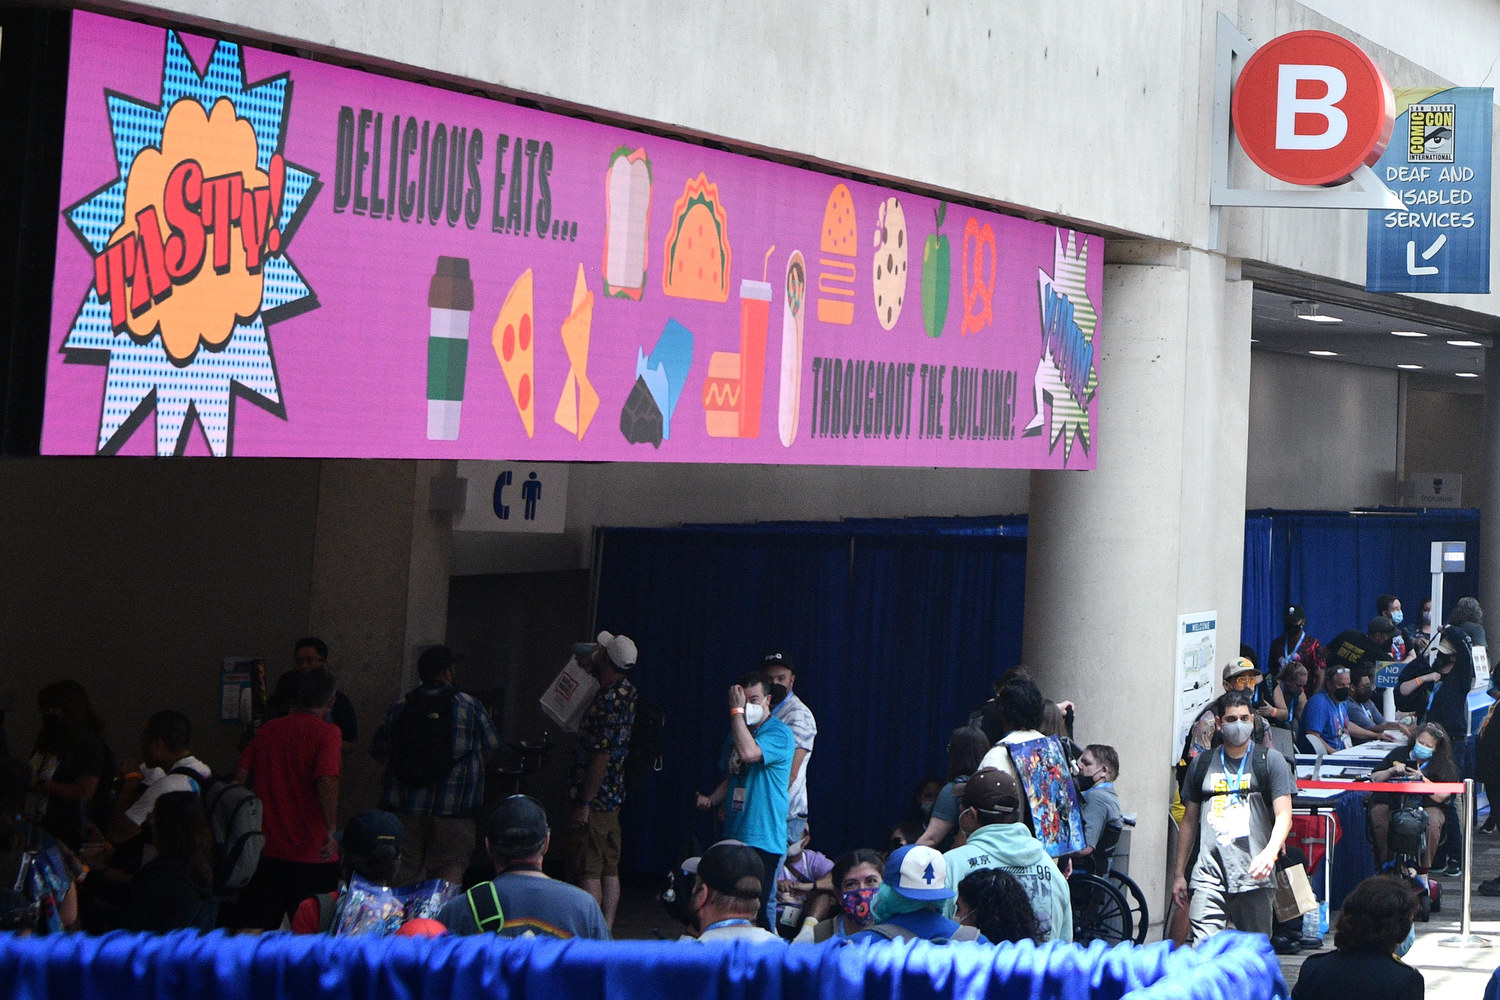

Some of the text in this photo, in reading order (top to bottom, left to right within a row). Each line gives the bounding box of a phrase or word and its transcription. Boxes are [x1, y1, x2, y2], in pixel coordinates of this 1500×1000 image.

[1275, 64, 1349, 151] B
[1425, 112, 1453, 126] CON
[1410, 112, 1425, 154] COMIC
[333, 106, 579, 242] DELICIOUS EATS...
[1386, 166, 1475, 183] DEAF AND
[1384, 212, 1475, 228] SERVICES
[95, 153, 286, 332] TASTY!
[811, 357, 1018, 440] THROUGHOUT THE BUILDING!
[1192, 622, 1210, 632] WELCOME
[1385, 666, 1399, 674] NO
[967, 854, 992, 868] 東京
[1036, 864, 1051, 881] 96
